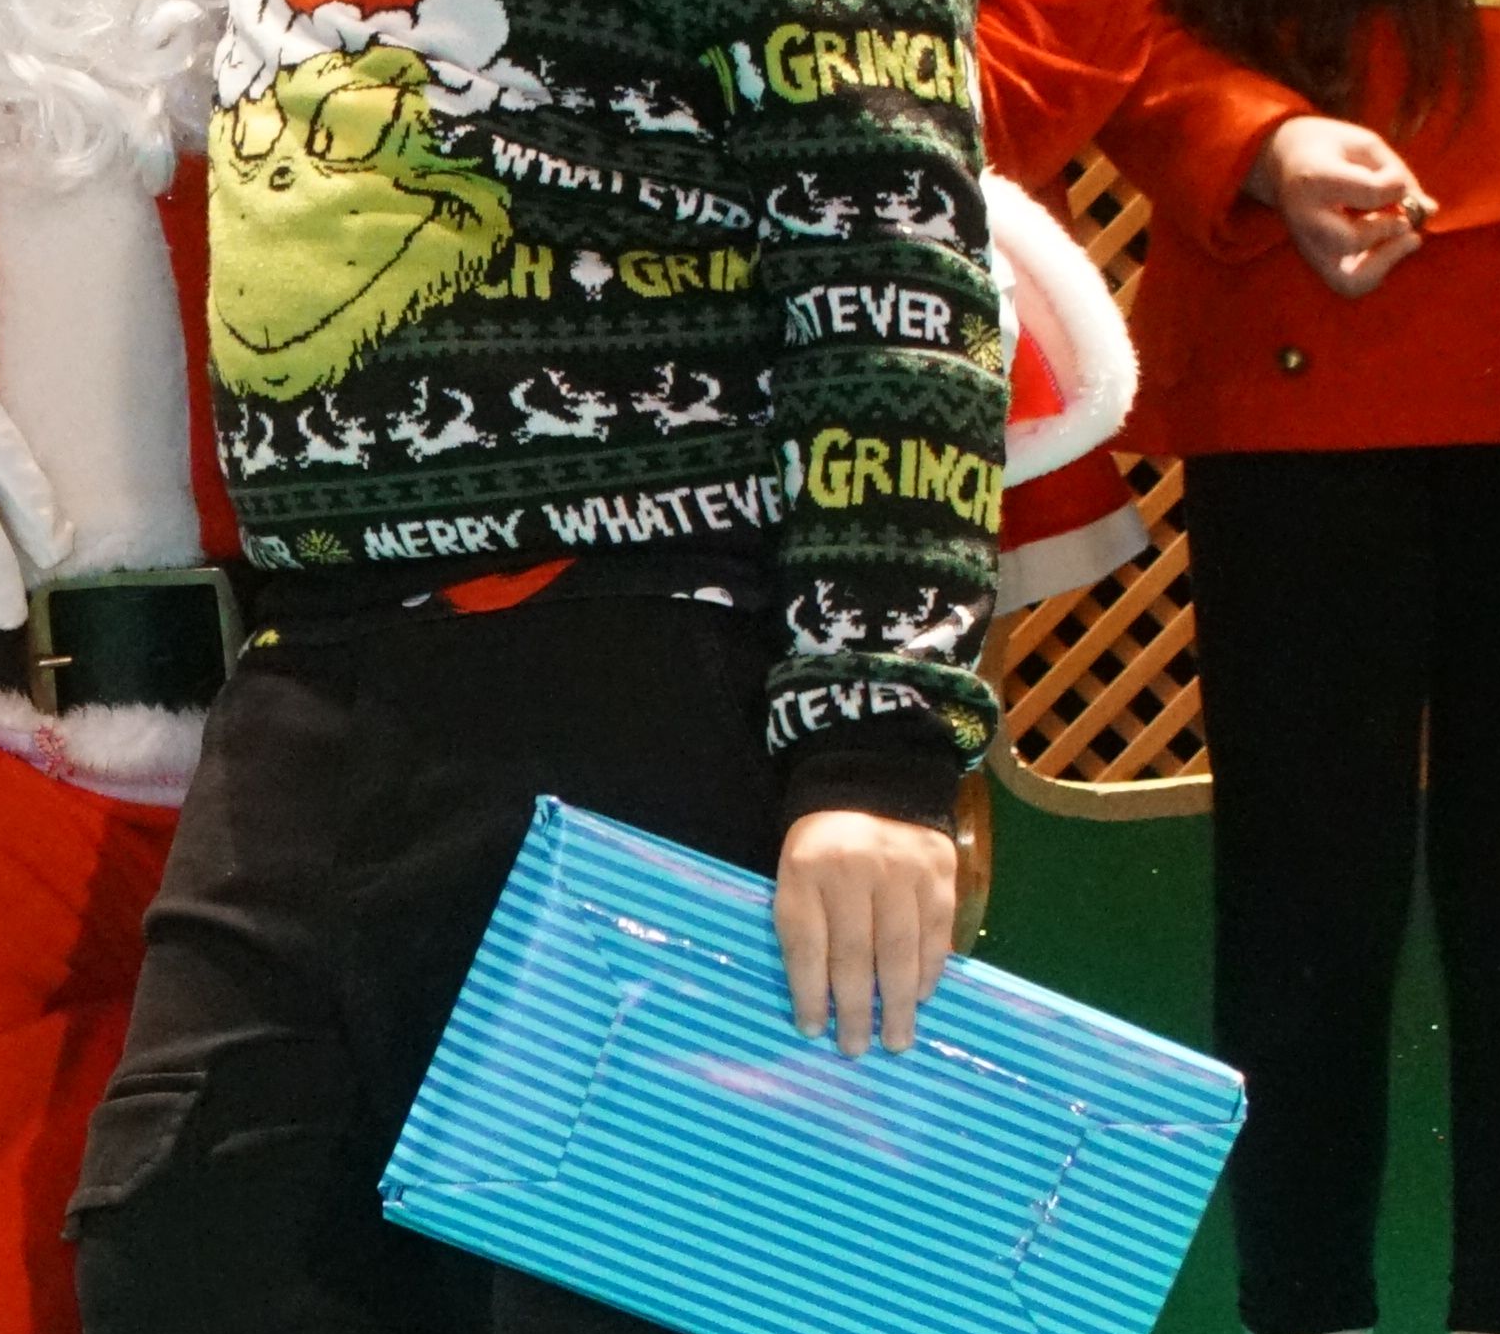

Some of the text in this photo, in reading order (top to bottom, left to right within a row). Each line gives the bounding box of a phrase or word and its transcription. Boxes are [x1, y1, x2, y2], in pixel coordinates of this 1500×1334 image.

[764, 23, 971, 110] GRINCH
[807, 428, 1003, 534] GRINCH
[363, 508, 525, 561] MERRY
